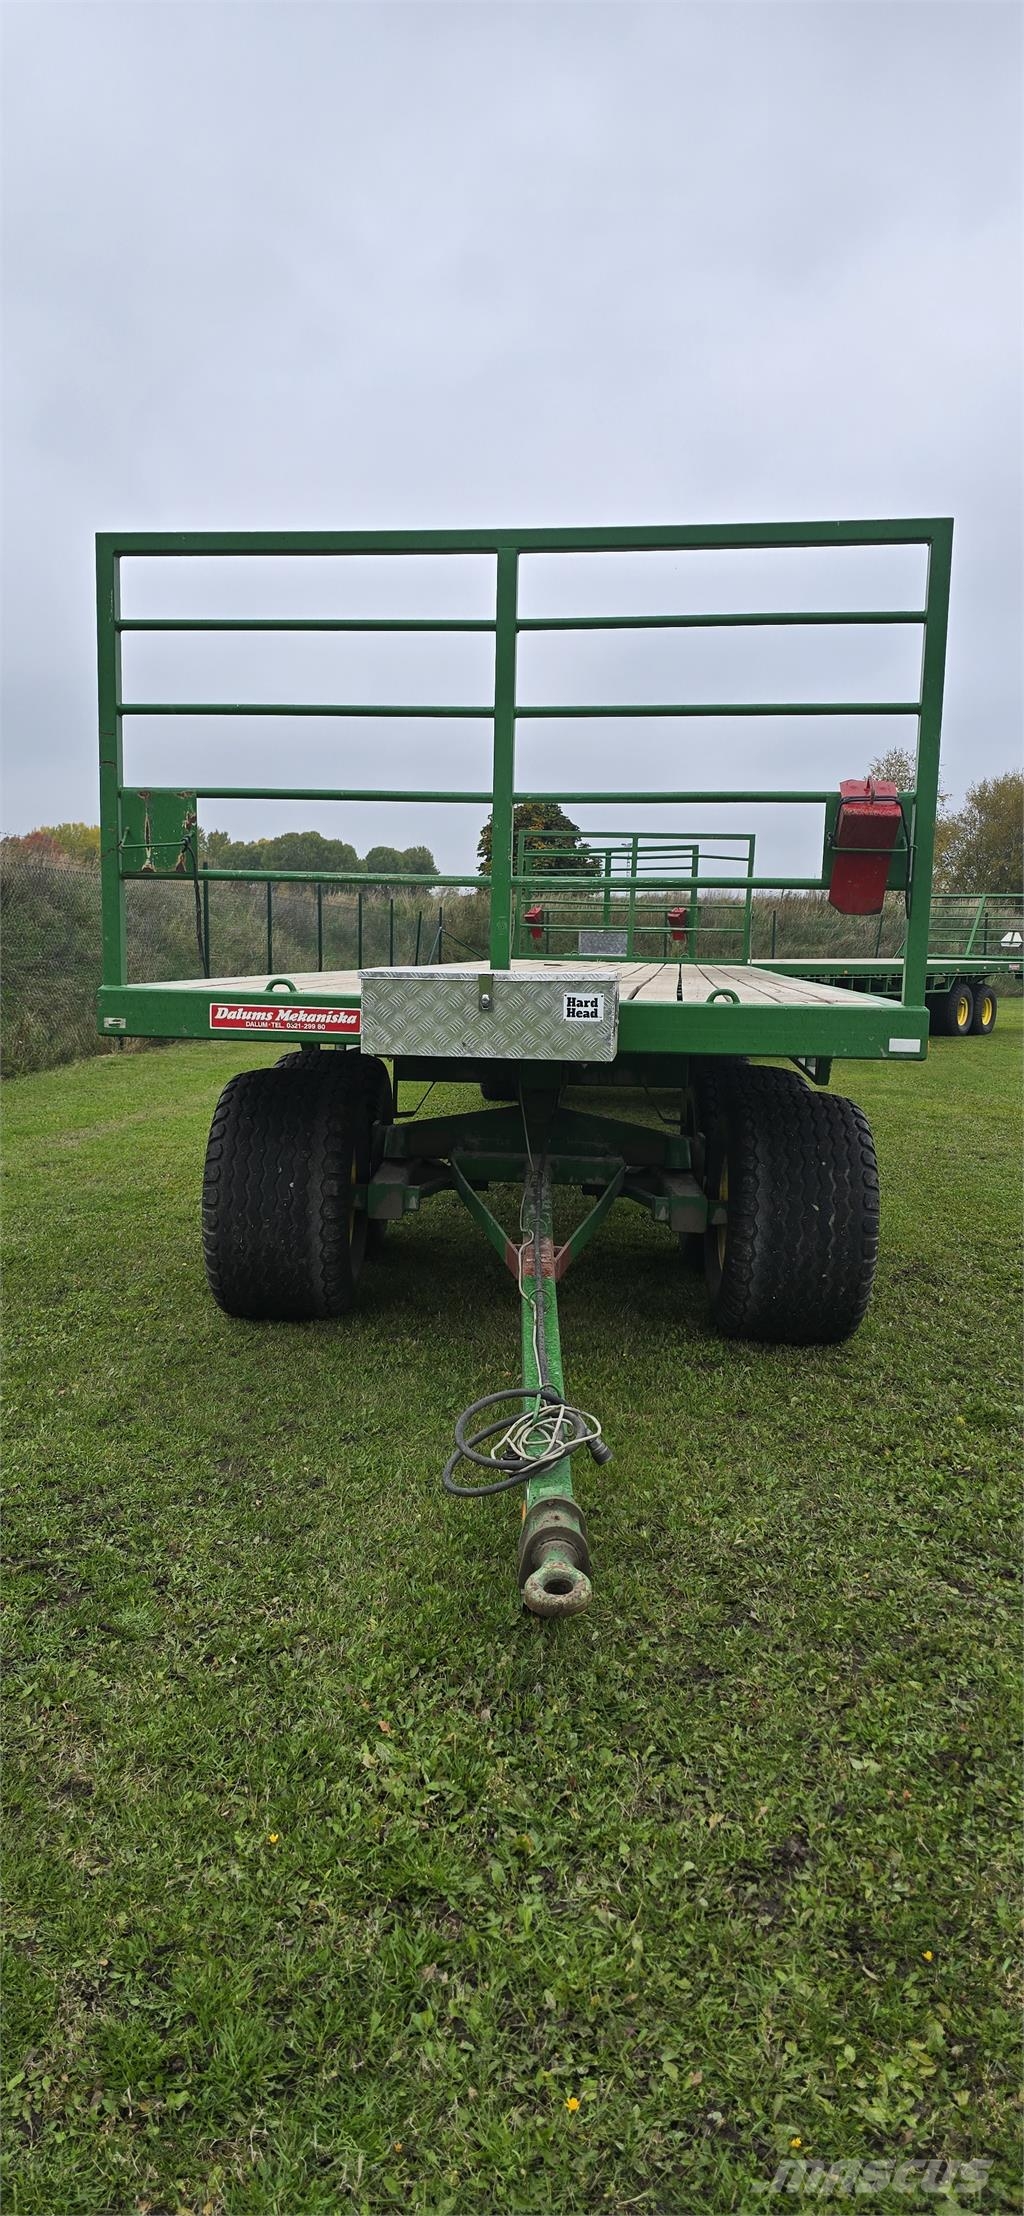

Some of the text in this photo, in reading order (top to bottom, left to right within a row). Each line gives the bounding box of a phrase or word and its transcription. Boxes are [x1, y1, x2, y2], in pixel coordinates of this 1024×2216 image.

[566, 997, 598, 1007] Hard
[214, 1007, 357, 1024] Dalums Mekaniska
[566, 1008, 598, 1018] Head
